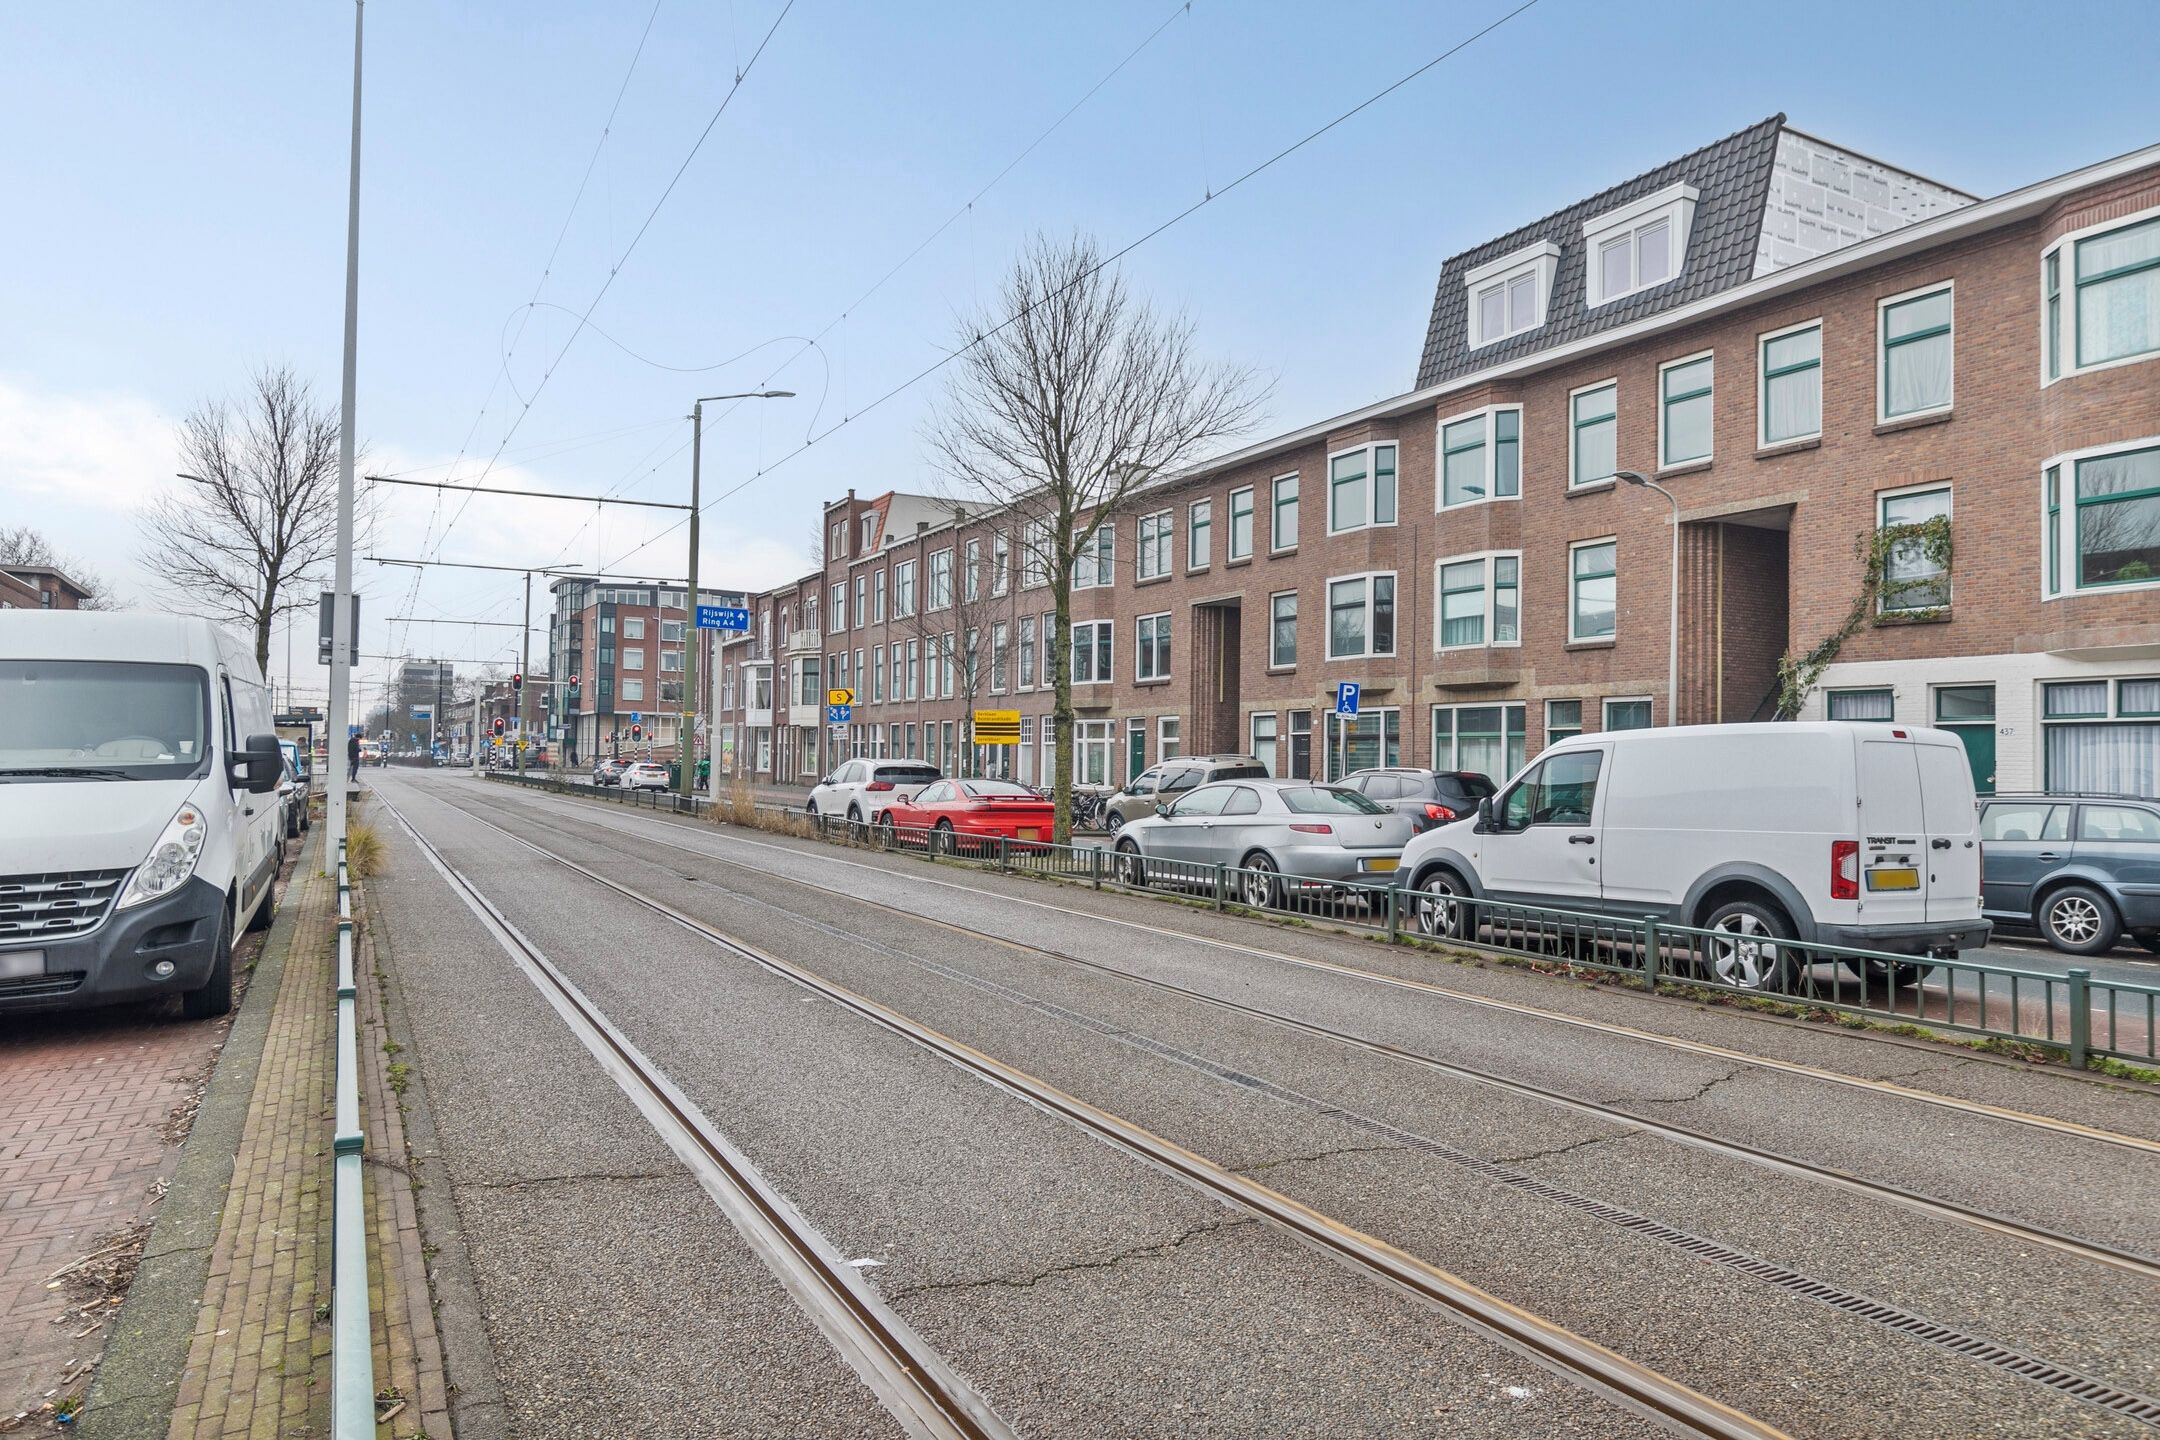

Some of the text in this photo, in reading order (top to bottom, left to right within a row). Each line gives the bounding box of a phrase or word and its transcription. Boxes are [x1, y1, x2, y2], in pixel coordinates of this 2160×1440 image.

[702, 609, 735, 619] Rijswijk
[702, 617, 721, 627] Ring
[836, 693, 842, 701] S
[1342, 684, 1356, 701] P
[1999, 727, 2014, 736] 437
[1866, 836, 1896, 844] TRANSIT
